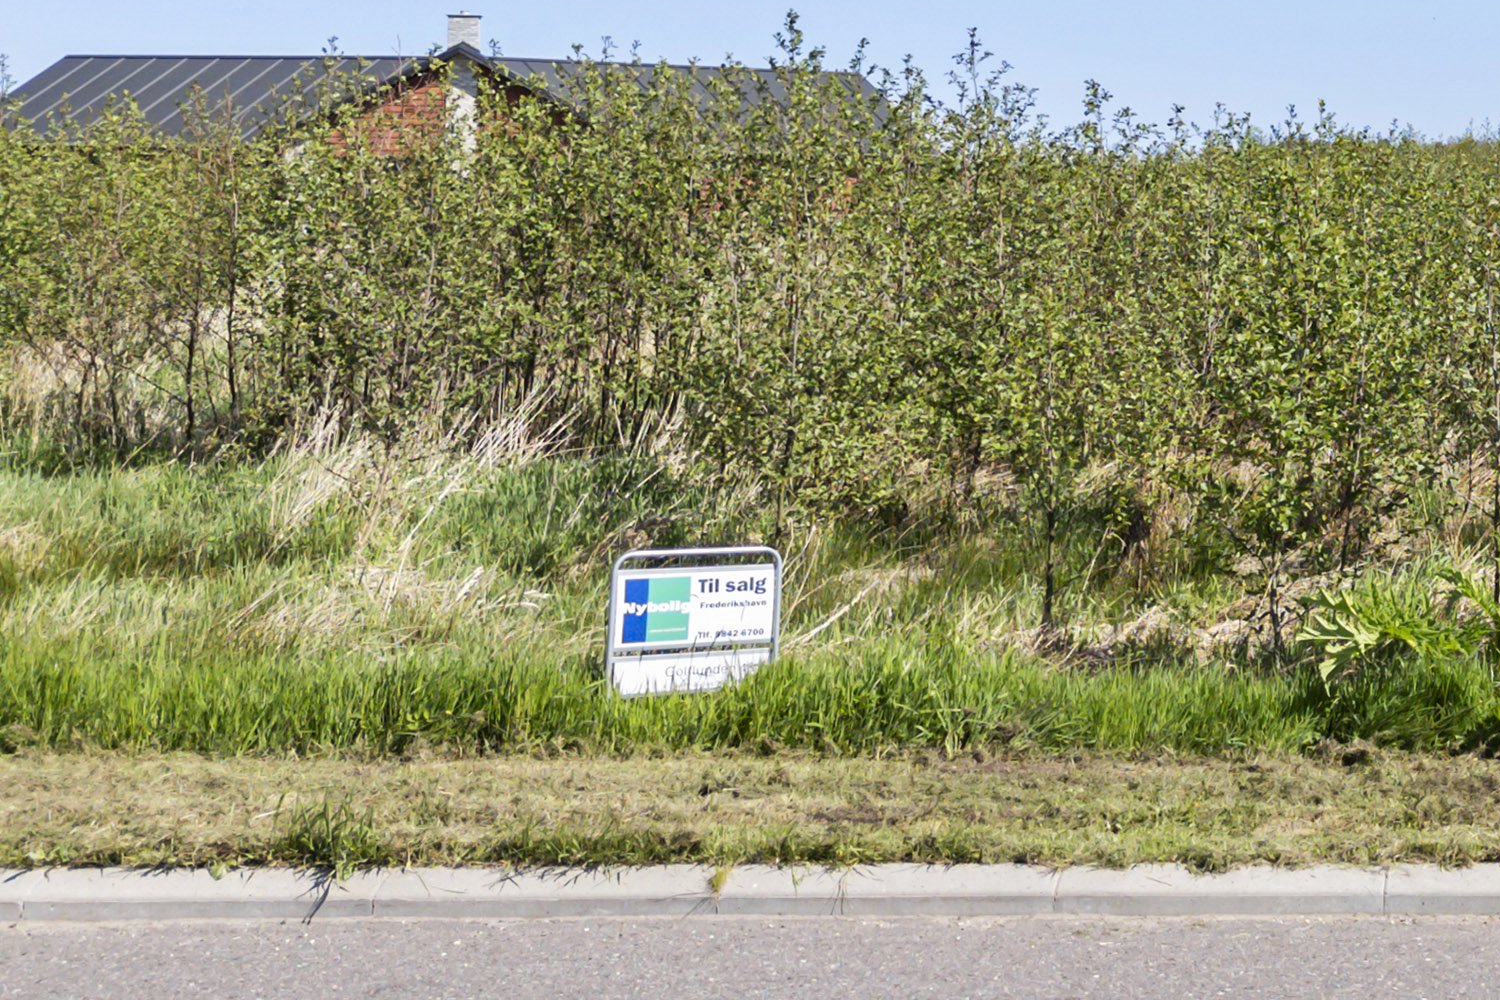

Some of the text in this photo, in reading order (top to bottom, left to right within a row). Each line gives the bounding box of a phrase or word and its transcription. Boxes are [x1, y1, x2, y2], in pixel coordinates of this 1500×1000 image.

[698, 576, 767, 594] Til salg
[623, 600, 692, 616] Nybolig
[700, 599, 767, 609] Frederikshavn
[740, 628, 764, 636] 6700
